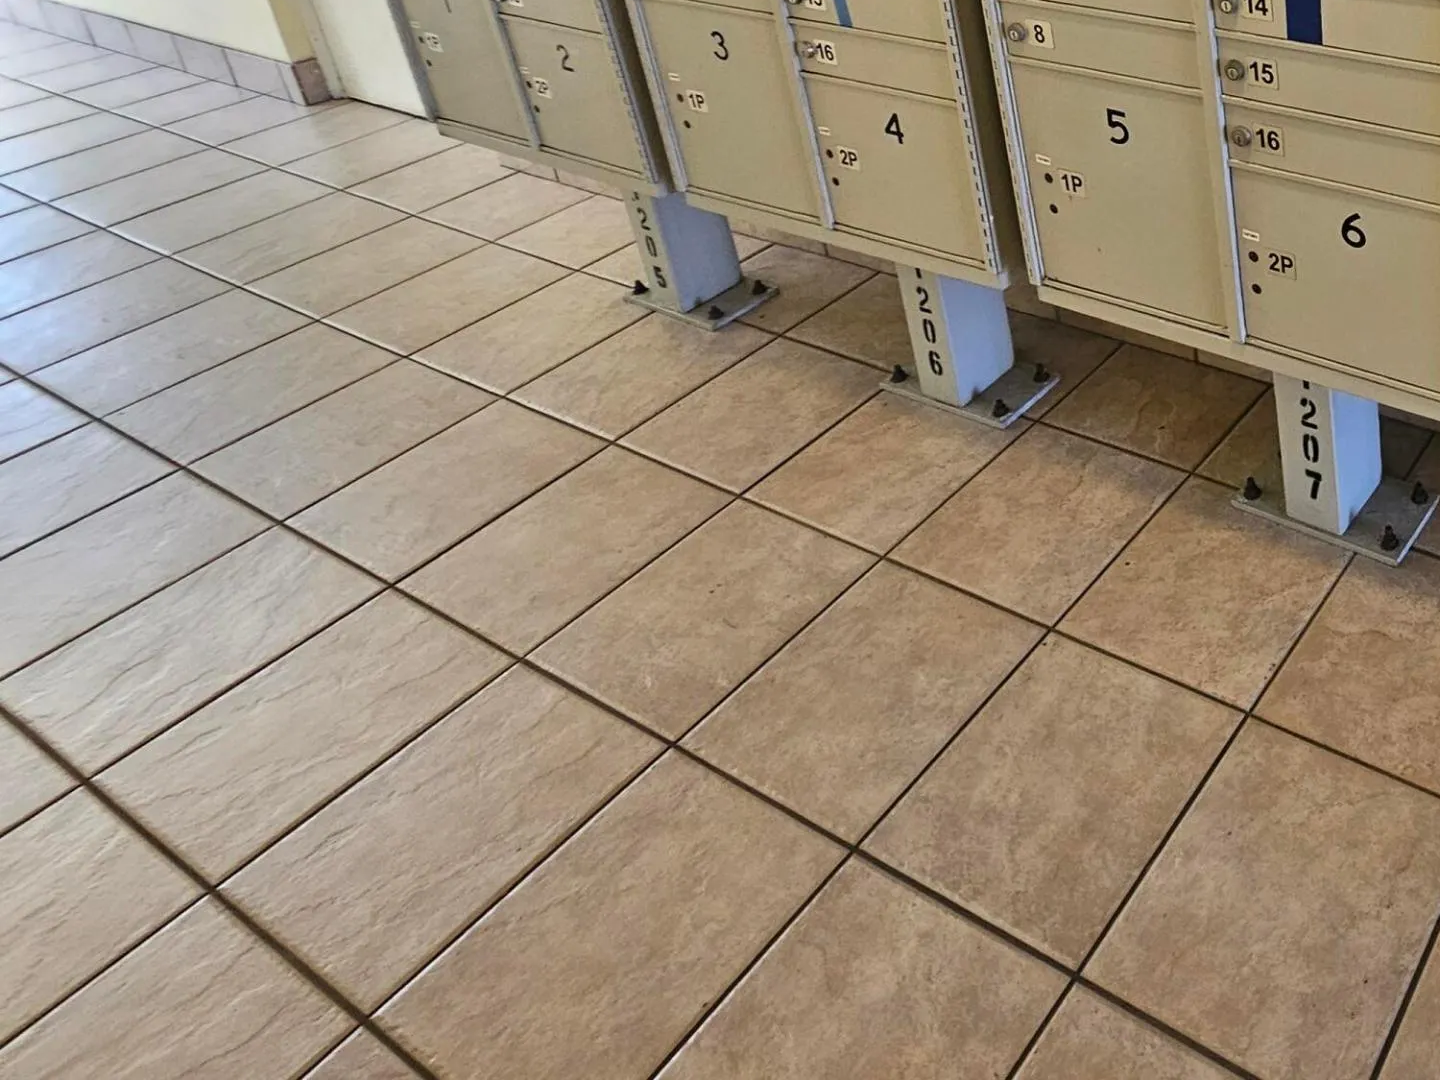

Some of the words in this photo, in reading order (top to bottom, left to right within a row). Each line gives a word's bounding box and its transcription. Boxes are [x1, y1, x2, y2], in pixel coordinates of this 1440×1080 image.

[1034, 25, 1045, 43] 8
[711, 31, 728, 60] 3
[816, 43, 834, 60] 16
[556, 43, 575, 72] 2
[1250, 62, 1273, 84] 15
[689, 94, 704, 108] 1P
[885, 113, 904, 144] 4
[1107, 108, 1129, 144] 5
[1256, 129, 1279, 150] 16
[840, 150, 857, 166] 2P
[1062, 174, 1082, 192] 1P
[632, 191, 668, 289] 205
[1342, 213, 1366, 248] 6
[1269, 253, 1293, 273] 2P
[1299, 380, 1323, 500] 207
